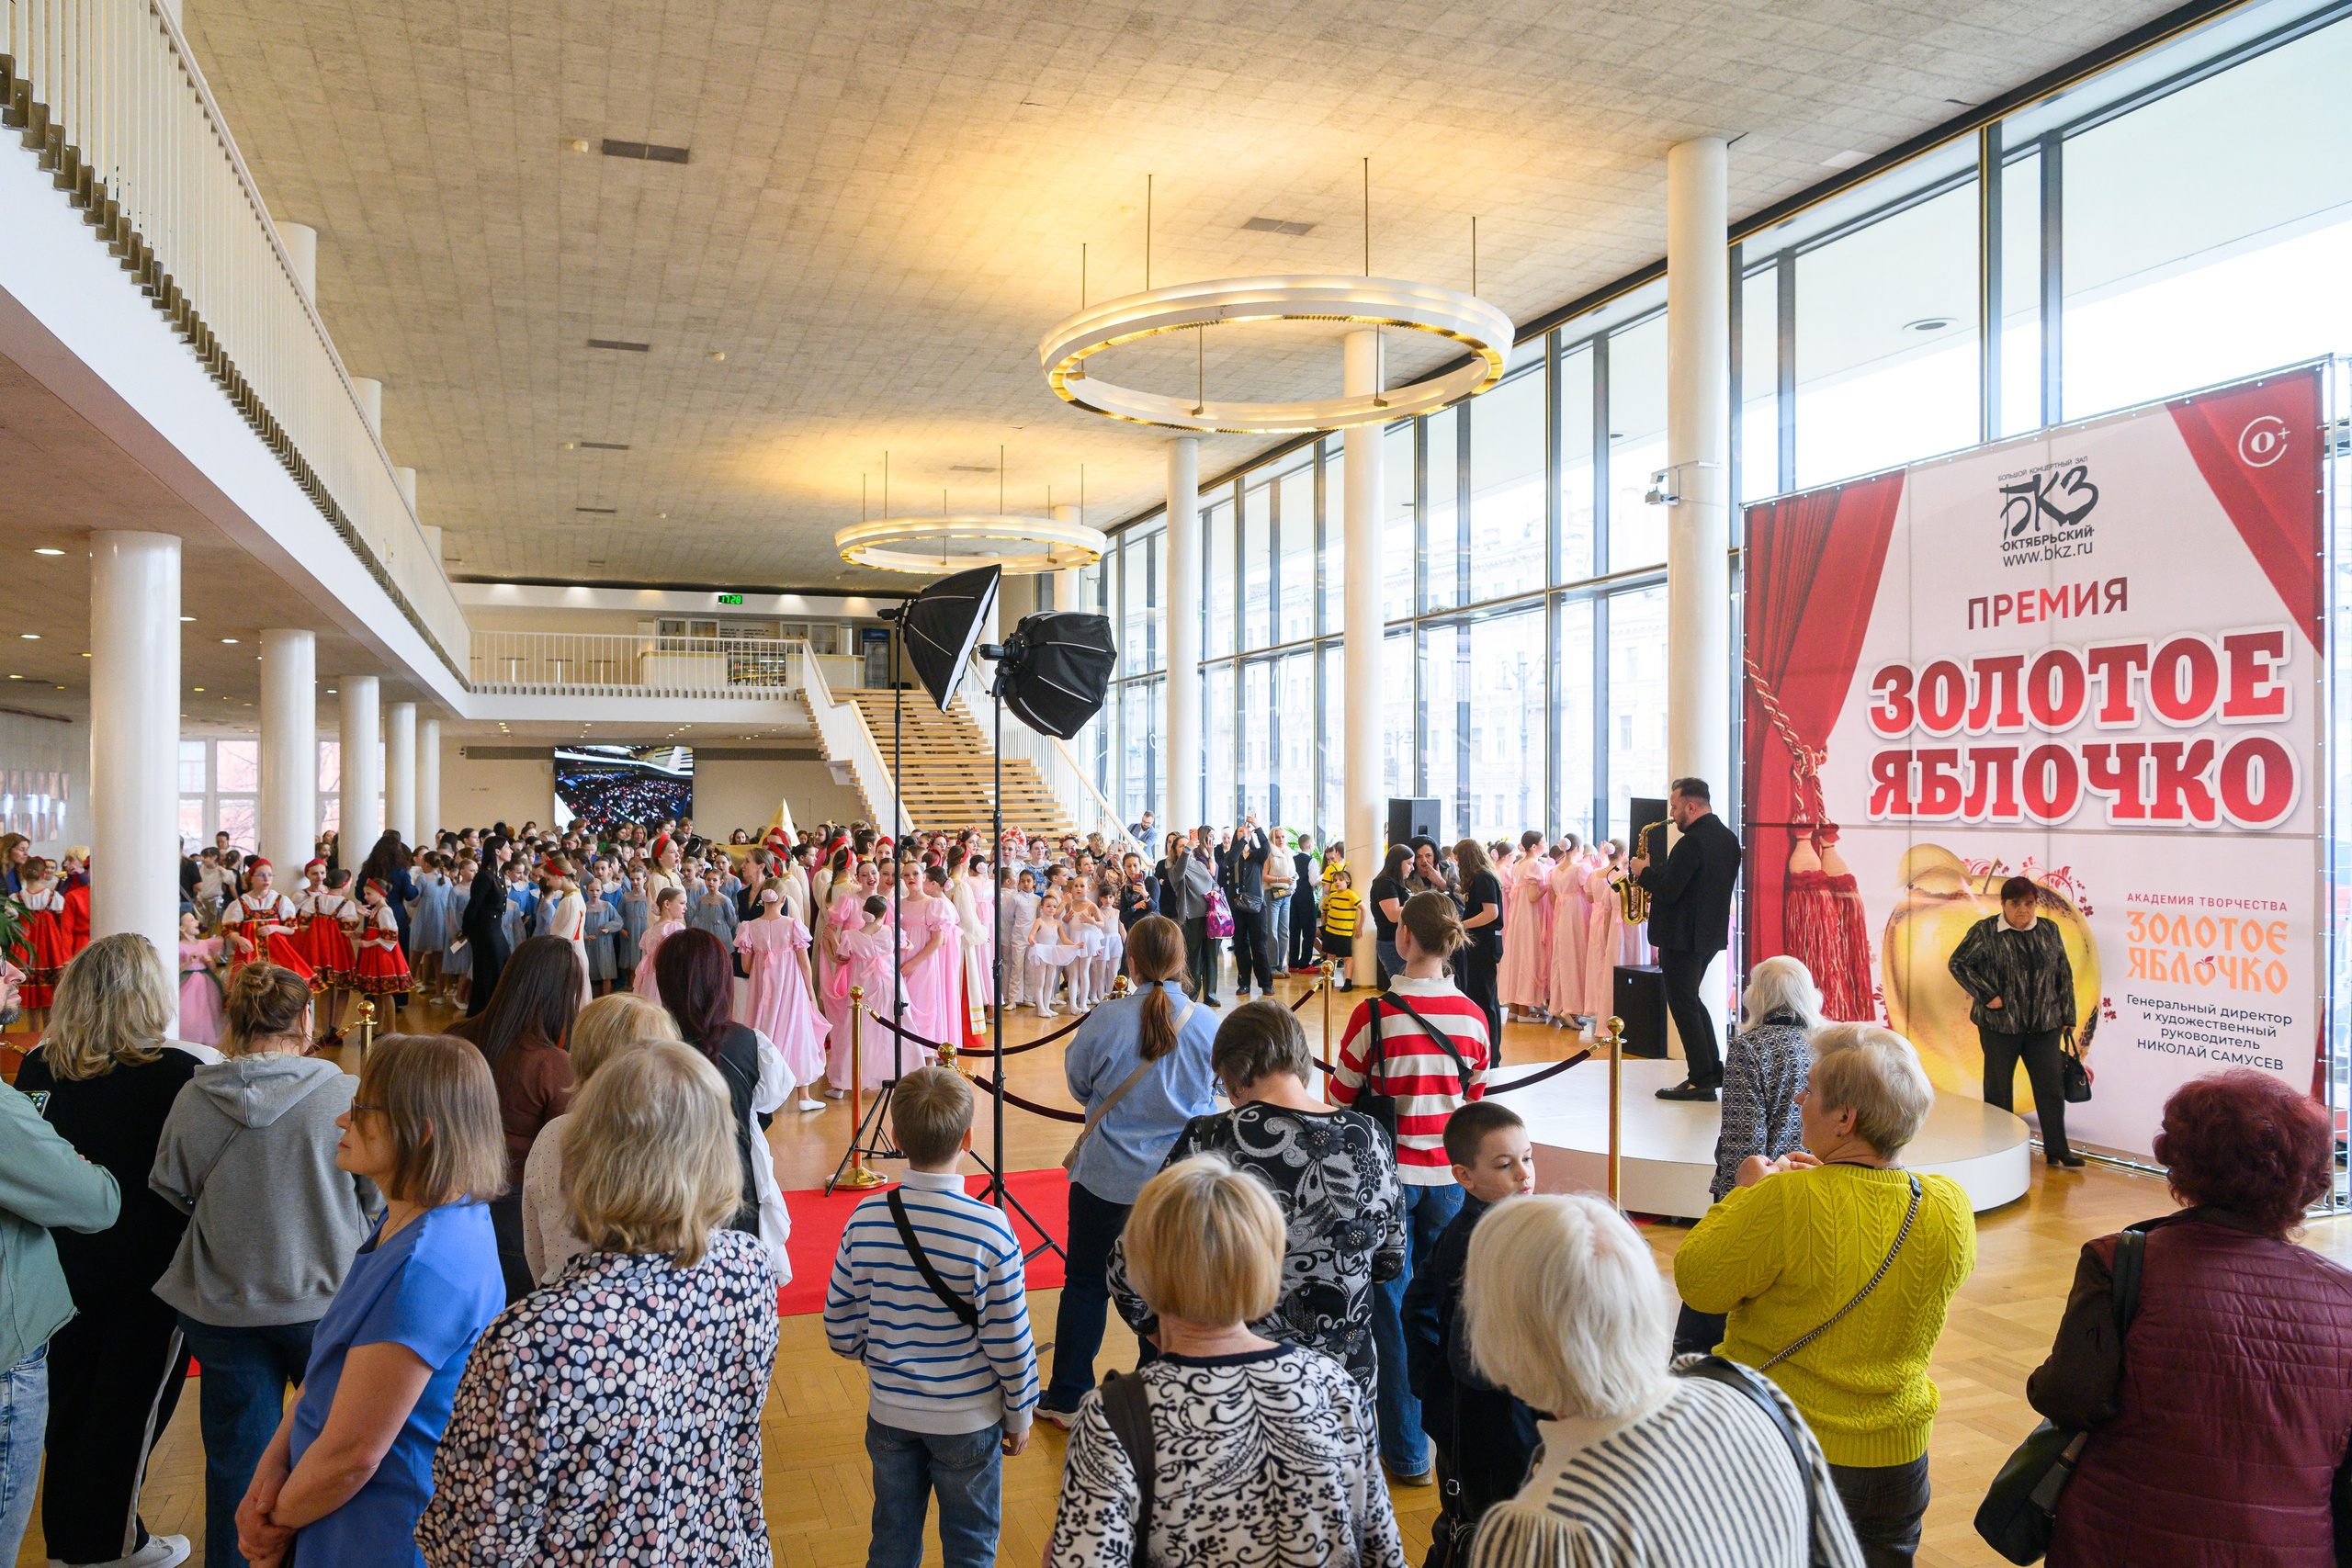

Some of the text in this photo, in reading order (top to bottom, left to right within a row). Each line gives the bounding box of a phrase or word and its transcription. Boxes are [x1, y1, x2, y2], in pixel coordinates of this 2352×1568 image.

[1997, 456, 2088, 482] БОЛЬШОЙ КОНЦЕРТНЫЙ ЗАЛ
[1999, 465, 2099, 541] БКЗ
[2001, 525, 2094, 552] ОКТЯБРЬСКИЙ
[2003, 541, 2093, 568] www.bkz.ru
[1968, 576, 2128, 630] ПРЕМИЯ
[1869, 629, 2287, 734] ЗОЛОТОЕ
[1869, 736, 2294, 824] ЯБЛОЧКО
[2127, 893, 2288, 912] АКАДЕМИЯ ТВОРЧЕСТВА
[2125, 910, 2289, 956] ЗОЛОТОЕ
[2126, 946, 2289, 995] ЯБЛОЧКО
[2127, 994, 2293, 1027] Генеральный директор
[2143, 1011, 2277, 1038] и художественный
[2137, 1038, 2285, 1071] НИКОЛАЙ САМУСЕВ
[2161, 1027, 2261, 1050] руководитель
